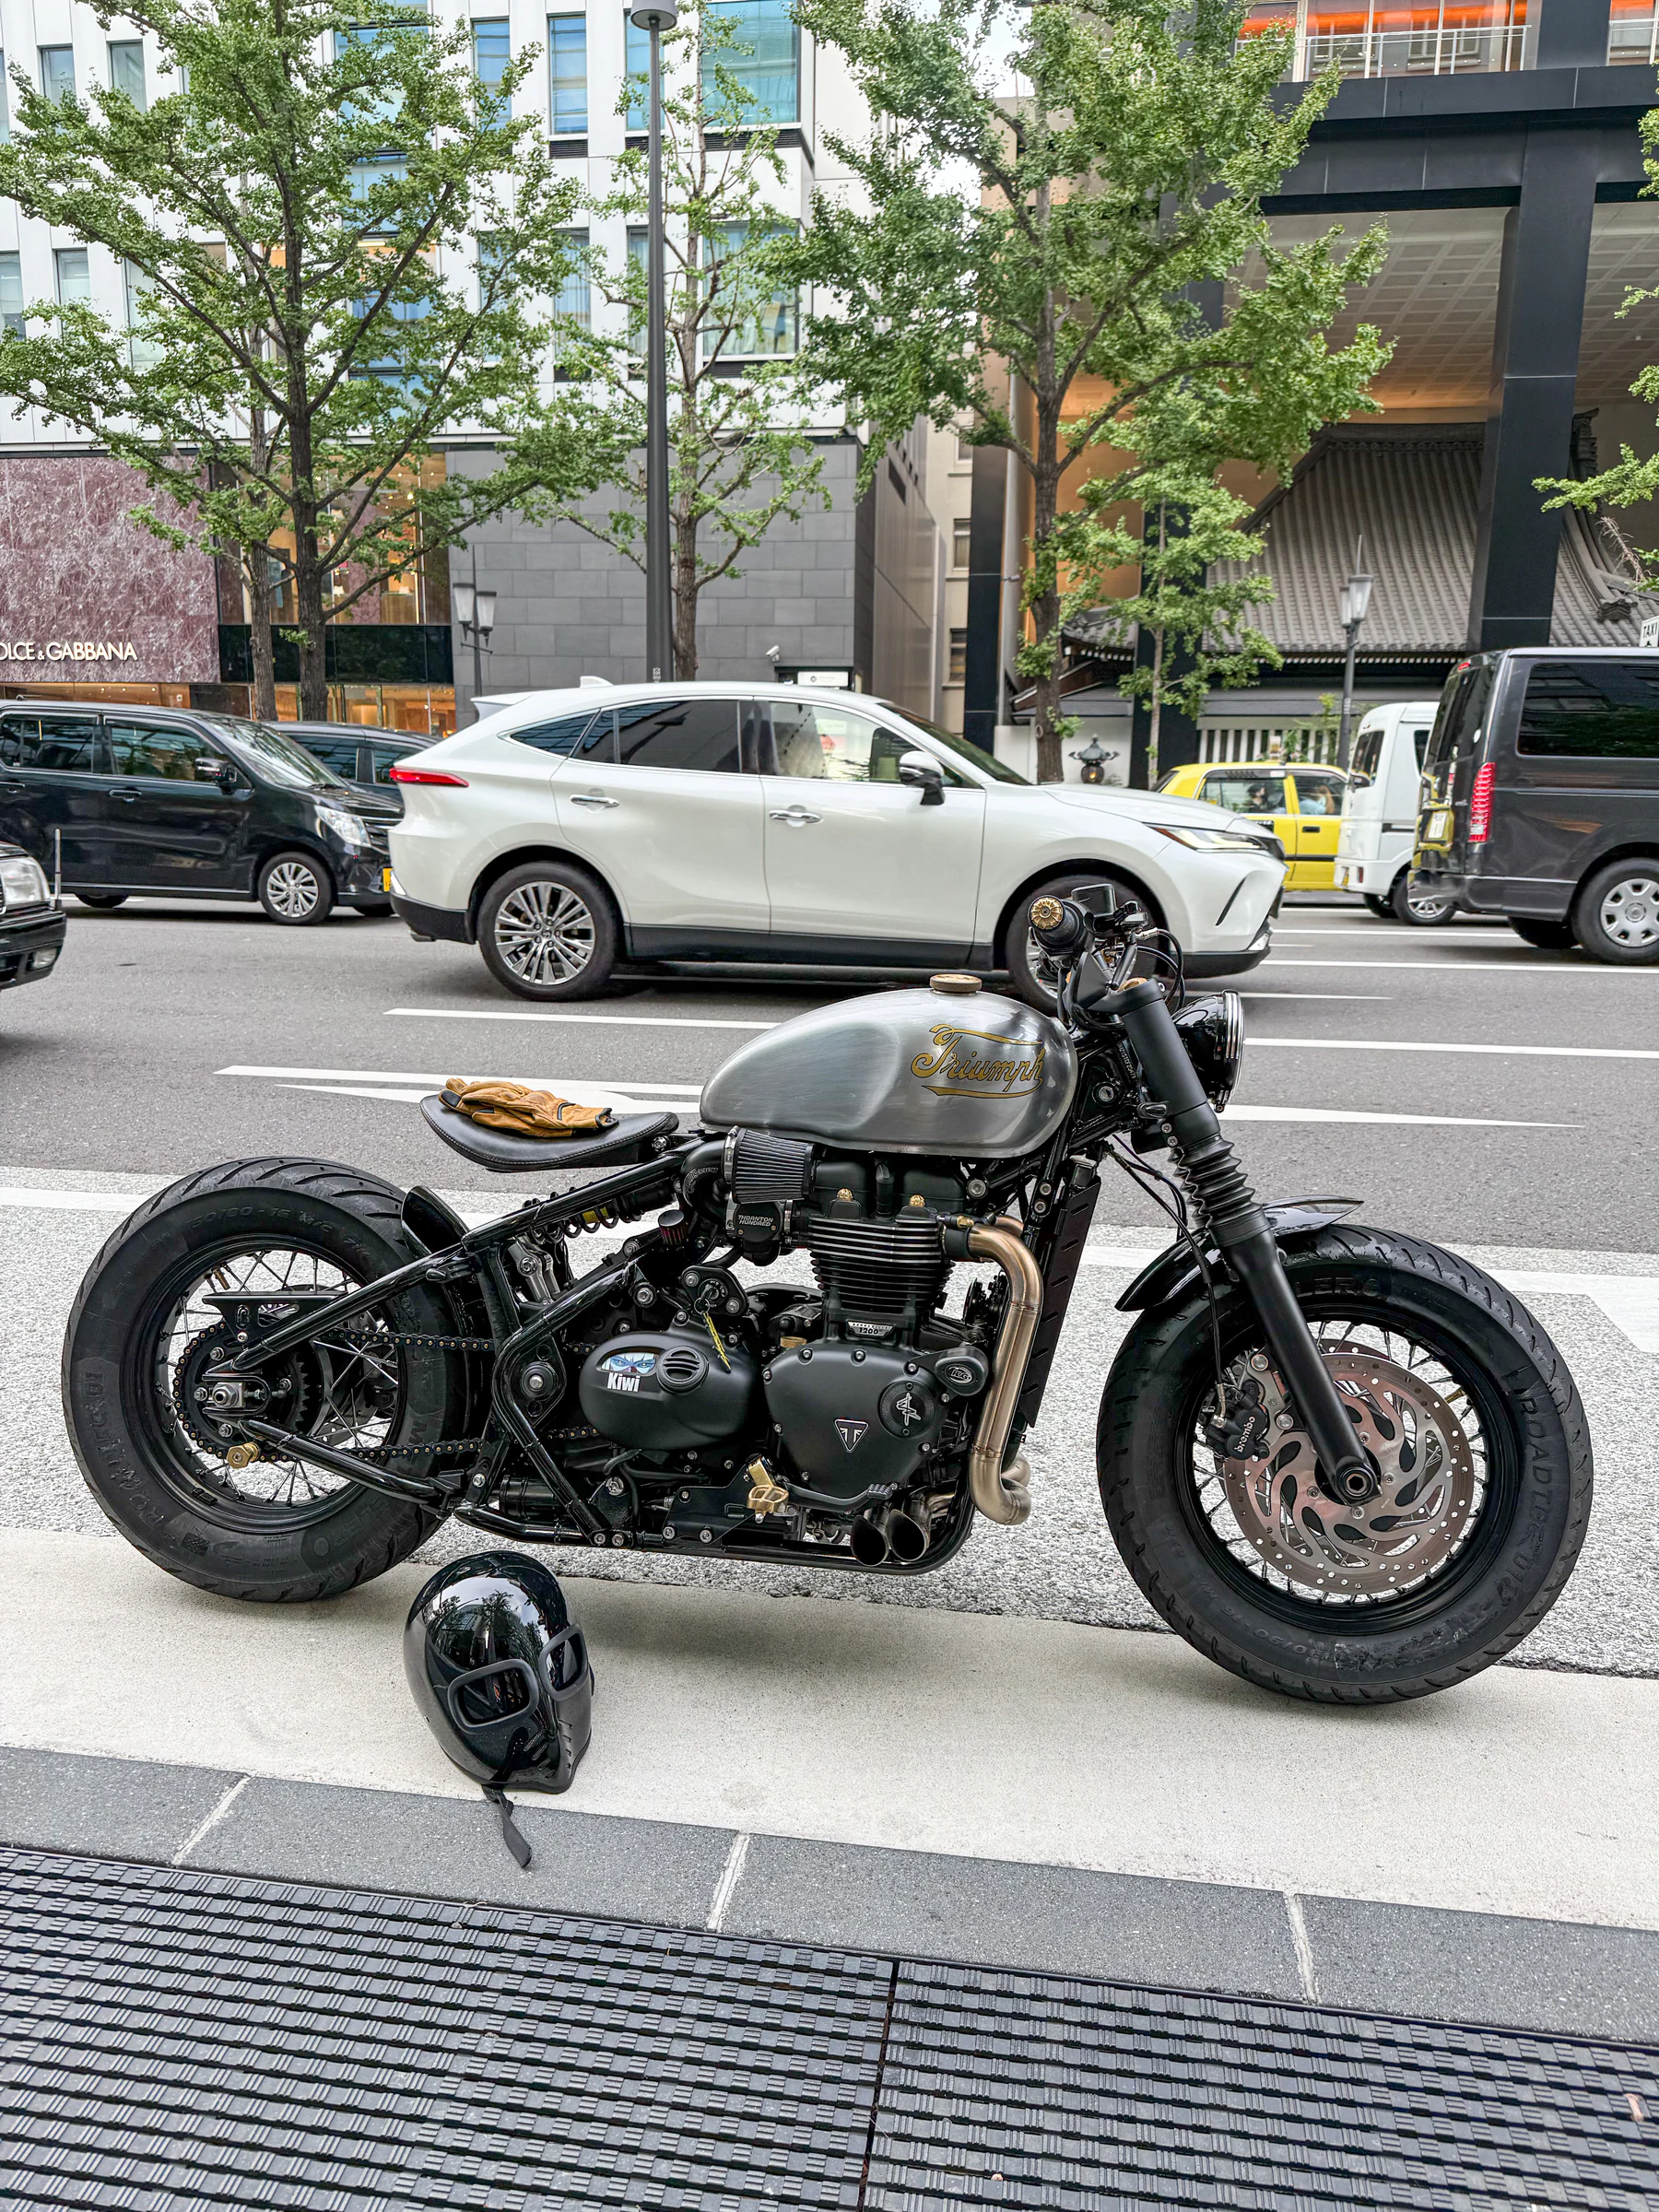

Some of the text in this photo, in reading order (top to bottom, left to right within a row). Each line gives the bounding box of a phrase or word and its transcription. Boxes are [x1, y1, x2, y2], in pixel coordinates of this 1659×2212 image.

[1642, 621, 1658, 638] TAXI
[37, 650, 45, 660] &
[46, 641, 137, 661] GABBANA
[911, 1024, 1047, 1099] Triumph
[738, 1214, 774, 1223] THORNTON
[607, 1372, 641, 1393] Kiwi
[1234, 1416, 1256, 1453] brembo
